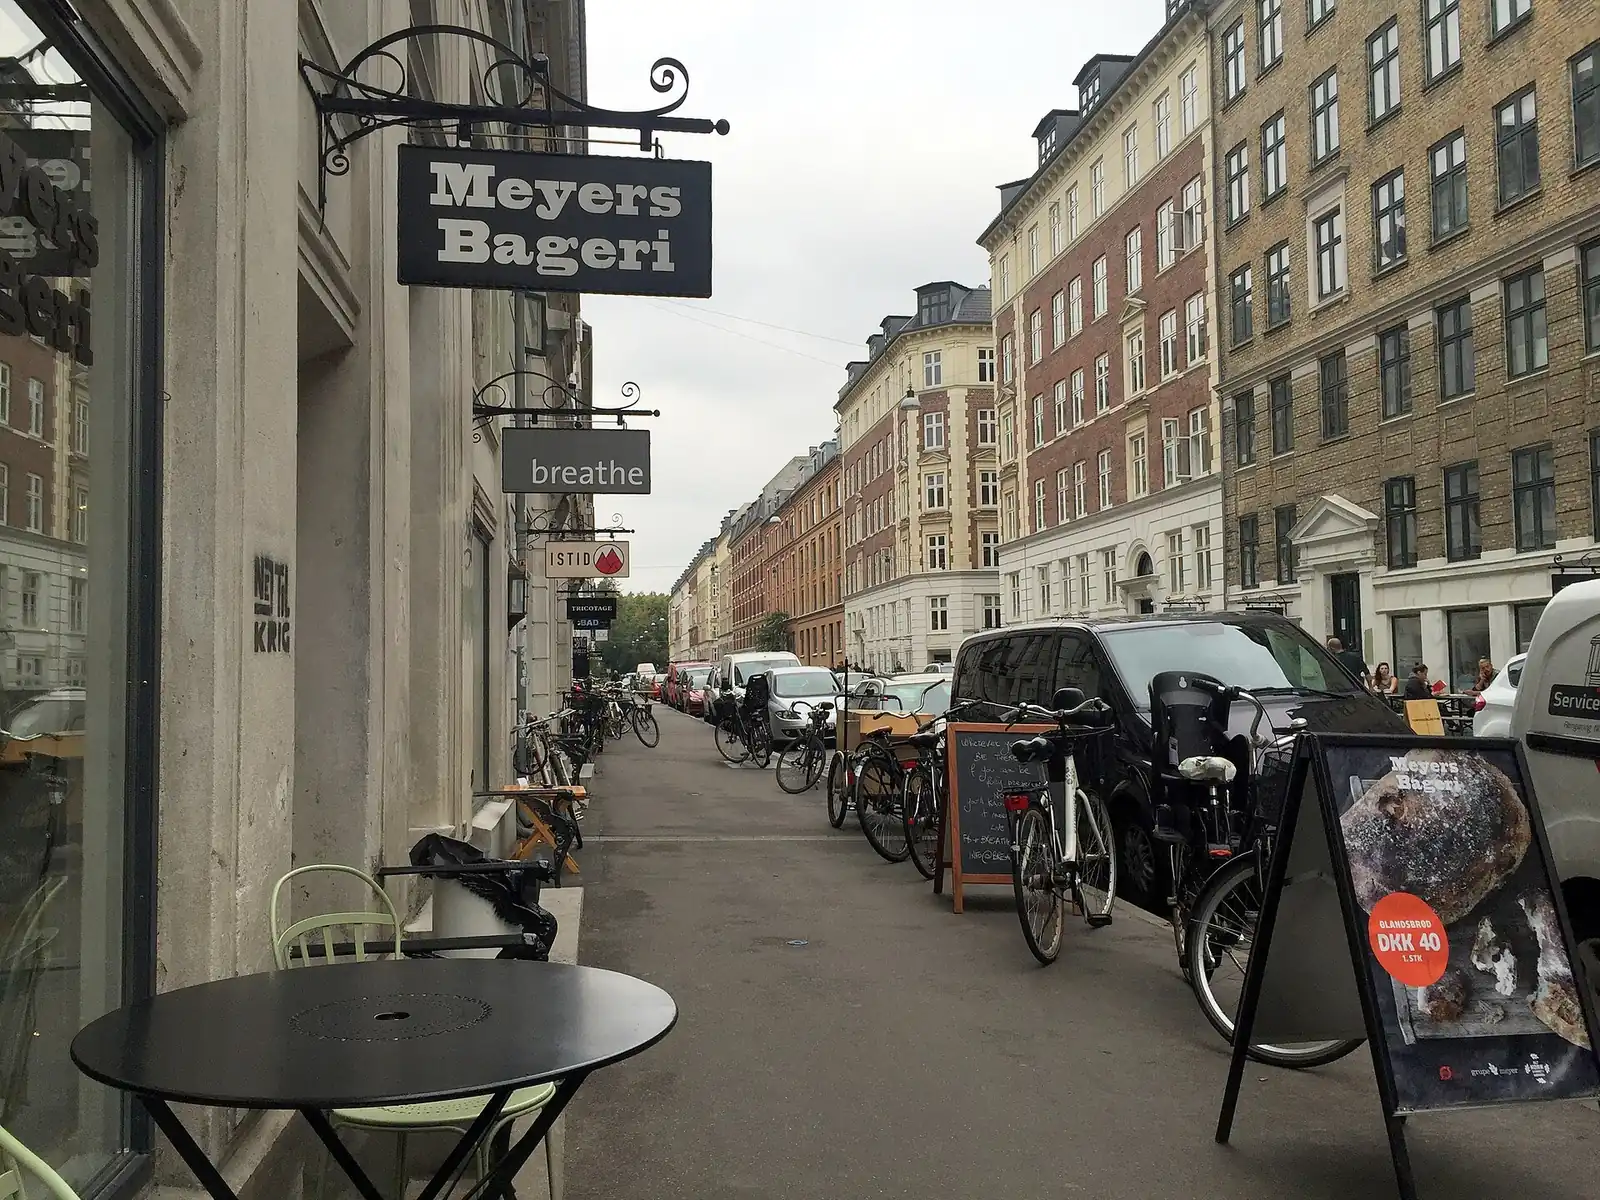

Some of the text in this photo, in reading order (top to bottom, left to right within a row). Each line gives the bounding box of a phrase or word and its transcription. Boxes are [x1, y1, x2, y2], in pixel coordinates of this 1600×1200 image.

[429, 161, 682, 220] Meyers
[437, 218, 675, 276] Bageri
[532, 458, 643, 485] breathe
[550, 552, 590, 566] ISTID
[254, 621, 290, 653] KRIG
[1553, 691, 1600, 711] Service
[1389, 756, 1459, 776] Meyers
[1396, 774, 1462, 794] Bageri
[1377, 932, 1441, 952] DKK 40
